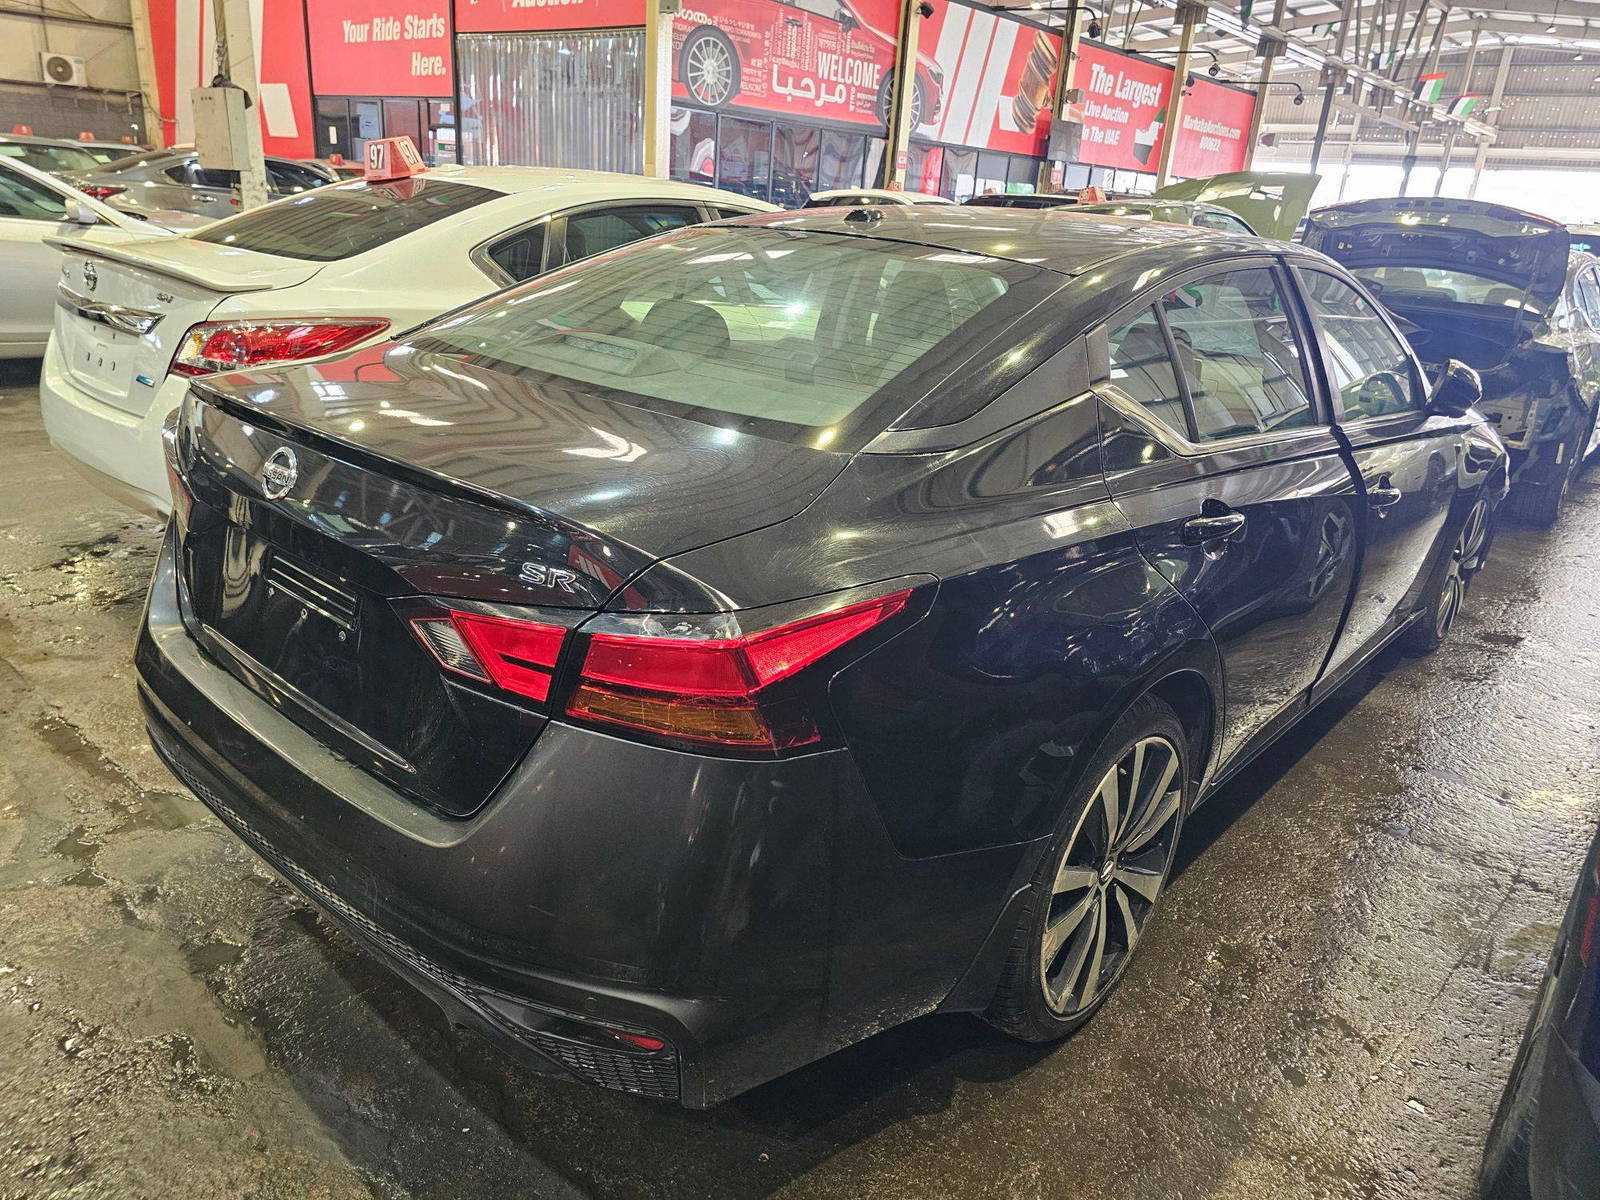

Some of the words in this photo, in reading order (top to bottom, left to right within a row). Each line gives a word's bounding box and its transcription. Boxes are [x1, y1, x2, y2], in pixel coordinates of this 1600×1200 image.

[342, 19, 370, 43] Your
[372, 16, 401, 41] Ride
[403, 13, 445, 40] Starts
[411, 51, 446, 76] Here.
[817, 51, 881, 90] WELCOME
[771, 63, 847, 107] مرحبا
[1089, 63, 1114, 96] The
[1115, 71, 1162, 109] Largest
[1084, 99, 1102, 119] Live
[1100, 104, 1129, 124] Auction
[1090, 126, 1105, 144] The
[1104, 128, 1121, 146] UAE
[369, 143, 385, 170] 97
[519, 562, 576, 594] SR
